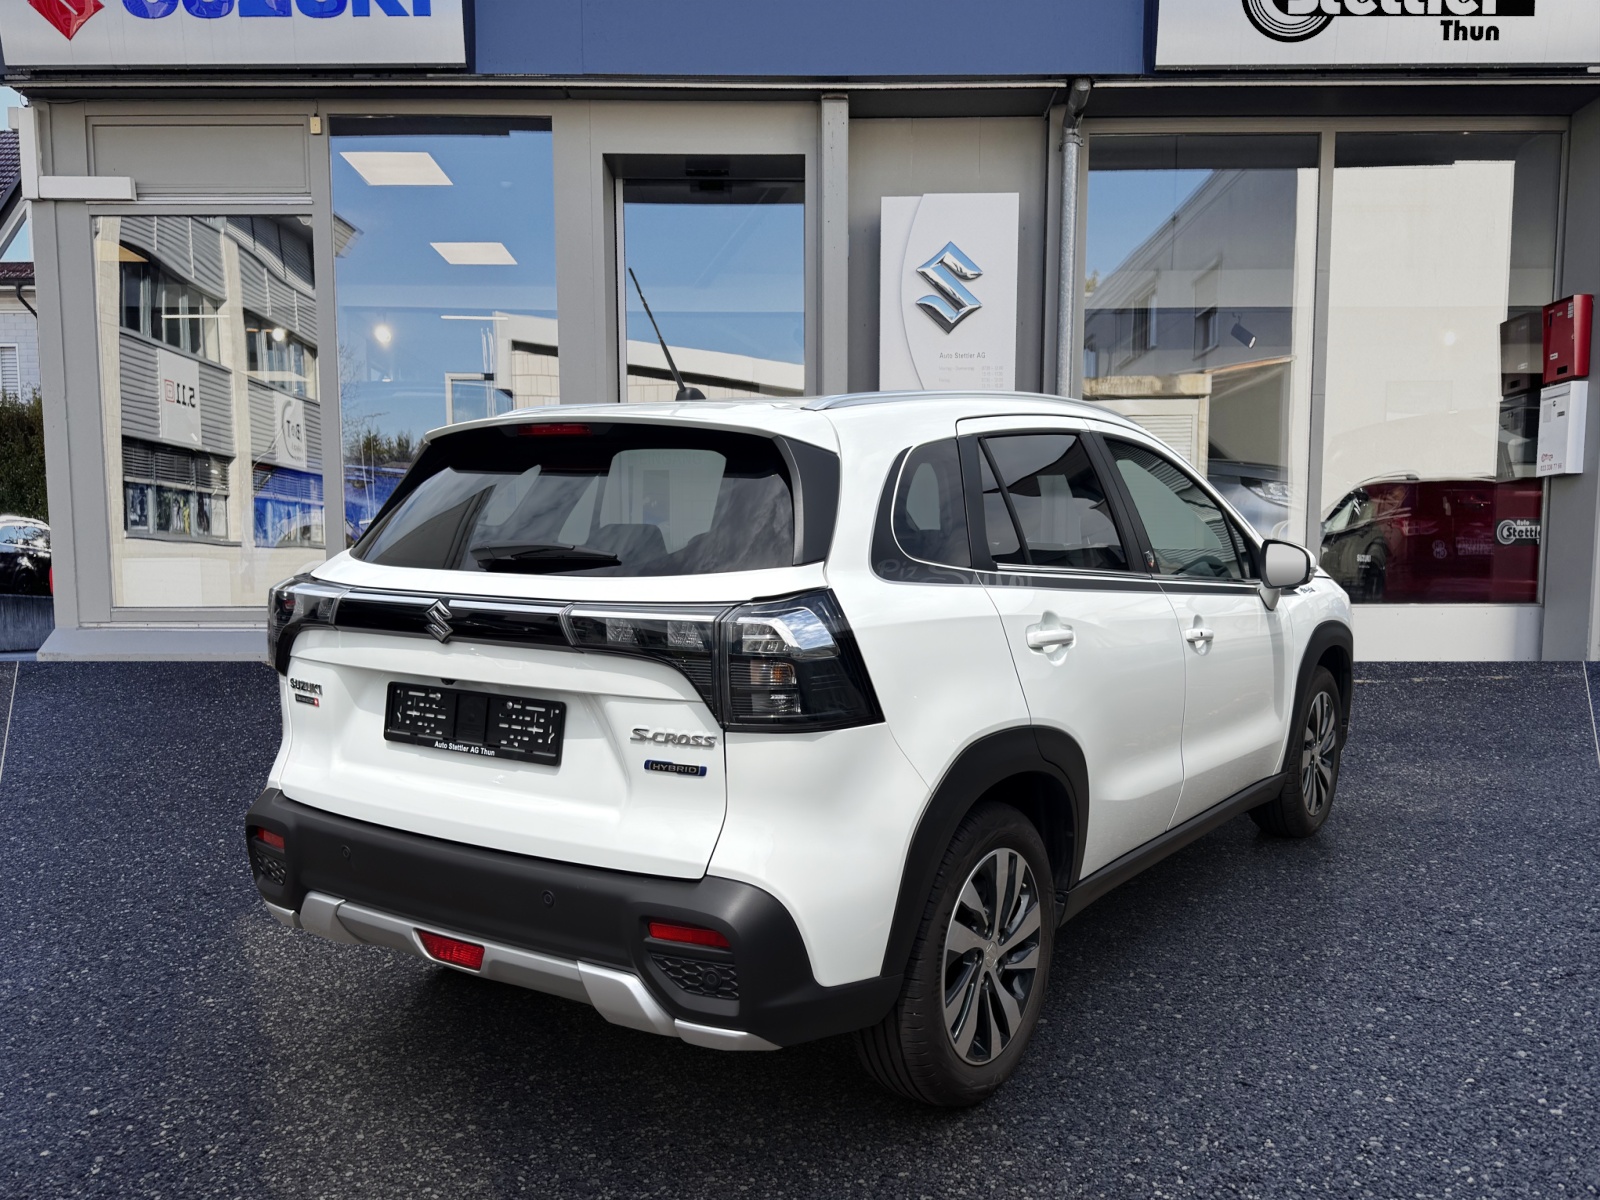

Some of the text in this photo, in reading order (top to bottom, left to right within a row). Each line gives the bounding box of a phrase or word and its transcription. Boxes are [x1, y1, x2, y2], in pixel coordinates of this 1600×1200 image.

[1441, 20, 1500, 41] Thun
[876, 558, 919, 580] Piz
[290, 678, 323, 695] SUZUKI
[434, 740, 496, 756] Auto Stettler AG Thun
[652, 763, 697, 774] HYBRID
